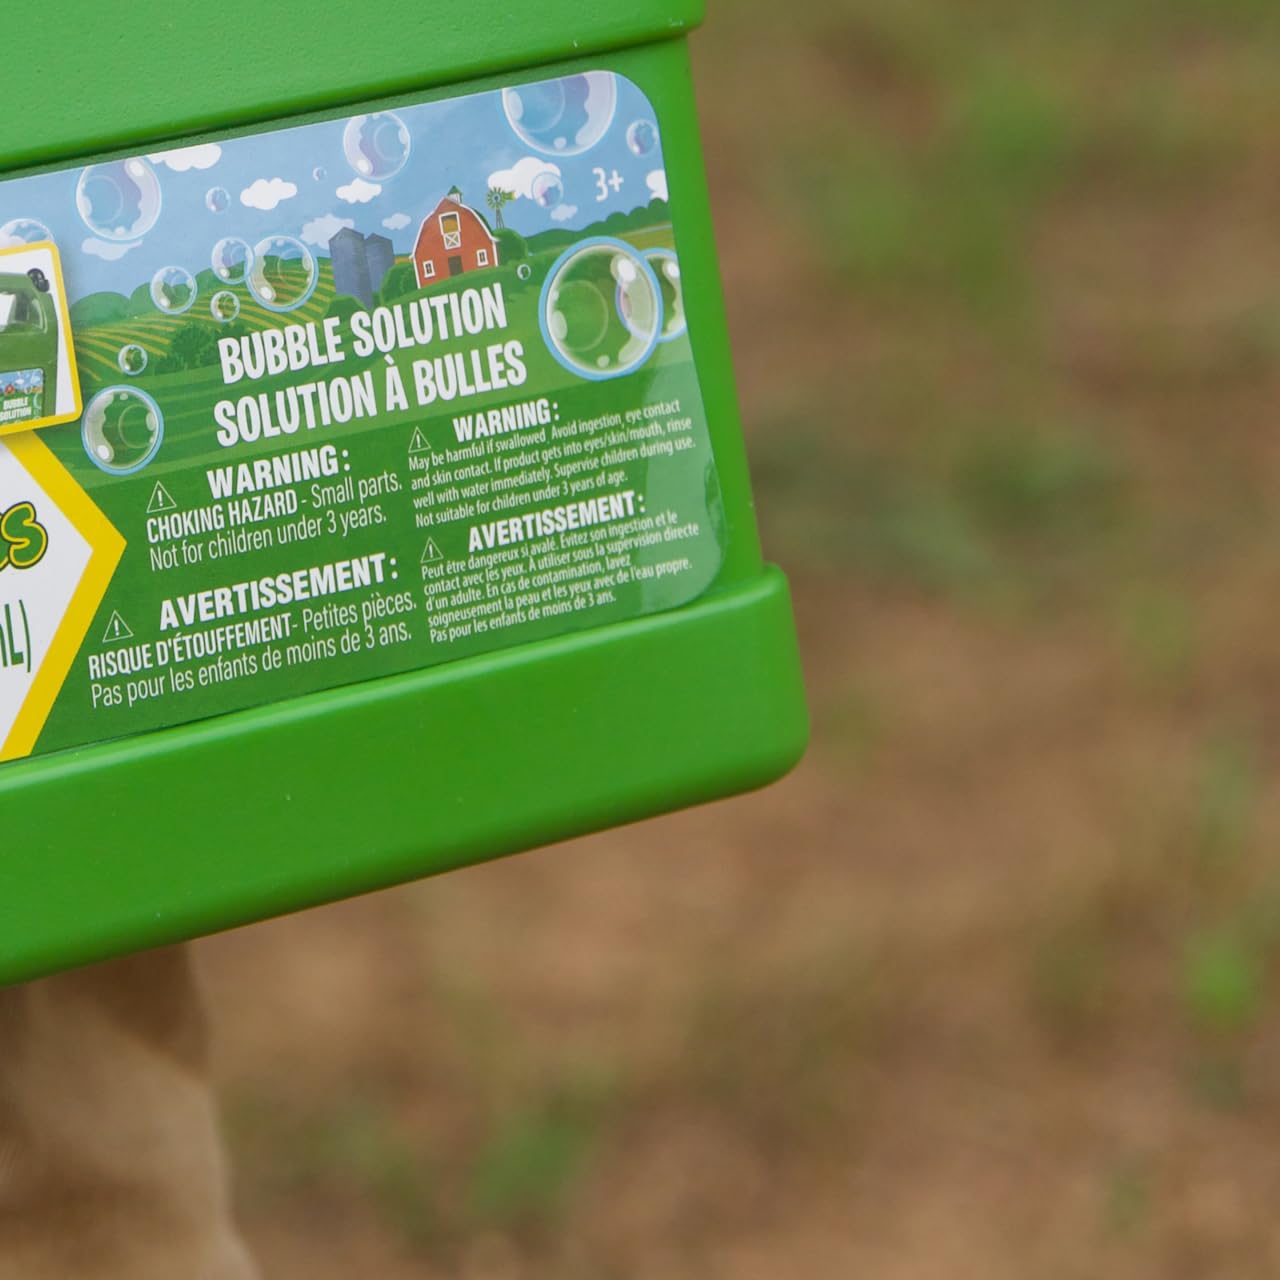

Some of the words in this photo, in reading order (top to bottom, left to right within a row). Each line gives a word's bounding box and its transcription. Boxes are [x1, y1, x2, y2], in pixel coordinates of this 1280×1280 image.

[592, 167, 624, 202] 3+
[218, 317, 345, 384] BUBBLE
[350, 282, 508, 359] SOLUTION
[0, 406, 32, 422] SOLUTION
[214, 371, 378, 448] SOLUTION
[384, 353, 407, 412] À
[412, 341, 527, 406] BULLES
[408, 456, 430, 472] May
[431, 452, 444, 466] be
[446, 441, 485, 462] harmful
[487, 439, 494, 454] if
[552, 422, 577, 440] Avoid
[579, 413, 625, 435] ingestion,
[626, 410, 641, 424] eye
[644, 399, 680, 418] contact
[411, 473, 430, 491] and
[432, 470, 452, 485] skin
[454, 462, 492, 480] contact.
[494, 457, 501, 471] If
[504, 452, 540, 473] product
[542, 448, 562, 464] gets
[564, 444, 582, 456] into
[667, 418, 692, 432] rinse
[146, 505, 225, 544] CHOKING
[229, 489, 298, 523] HAZARD
[311, 477, 354, 509] Small
[359, 471, 403, 501] parts.
[413, 491, 434, 509] well
[436, 487, 459, 504] with
[461, 482, 489, 498] water
[491, 467, 553, 491] immediately.
[554, 457, 599, 478] Supervise
[601, 448, 638, 466] children
[641, 439, 673, 458] during
[675, 437, 696, 449] use.
[416, 513, 434, 528] Not
[436, 503, 474, 524] suitable
[476, 500, 490, 514] for
[492, 492, 531, 511] children
[533, 484, 560, 502] under
[563, 481, 568, 495] 3
[570, 476, 595, 496] years
[596, 471, 606, 487] of
[608, 470, 628, 487] age.
[149, 546, 179, 571] Not
[182, 540, 203, 561] for
[208, 527, 273, 559] children
[277, 515, 322, 544] under
[328, 511, 336, 533] 3
[341, 505, 386, 536] years.
[422, 564, 445, 580] Peut
[468, 550, 519, 569] dangereux
[521, 544, 529, 558] si
[590, 528, 607, 542] son
[608, 518, 654, 538] ingestion
[656, 512, 666, 527] et
[668, 510, 677, 524] le
[424, 577, 460, 596] contact
[463, 575, 484, 587] avec
[486, 568, 499, 582] les
[501, 565, 527, 580] yeux.
[538, 552, 571, 570] utiliser
[573, 547, 594, 561] sous
[595, 542, 605, 556] la
[607, 532, 662, 554] supervision
[664, 523, 699, 541] directe
[428, 600, 502, 628] soigneusement
[504, 597, 514, 609] la
[516, 592, 540, 611] peau
[542, 587, 551, 601] et
[553, 584, 568, 598] les
[569, 582, 592, 598] yeux
[594, 577, 615, 589] avec
[617, 570, 629, 584] de
[656, 558, 692, 578] propre.
[451, 589, 485, 606] adulte.
[486, 583, 498, 598] En
[501, 582, 516, 594] cas
[518, 576, 529, 590] de
[532, 560, 605, 586] contamination,
[605, 554, 631, 571] lavez
[88, 645, 152, 680] RISQUE
[303, 604, 357, 633] Petites
[362, 590, 416, 620] pièces.
[430, 628, 448, 644] Pas
[449, 623, 472, 642] pour
[473, 619, 488, 633] les
[490, 612, 526, 629] enfants
[528, 606, 540, 620] de
[542, 602, 572, 618] moins
[574, 596, 586, 610] de
[588, 592, 594, 607] 3
[596, 591, 616, 605] ans.
[91, 683, 122, 709] Pas
[127, 679, 164, 708] pour
[170, 668, 194, 693] les
[198, 653, 258, 685] enfants
[262, 651, 281, 671] de
[287, 637, 336, 666] moins
[341, 633, 360, 654] de
[365, 626, 375, 648] 3
[379, 621, 412, 646] ans.
